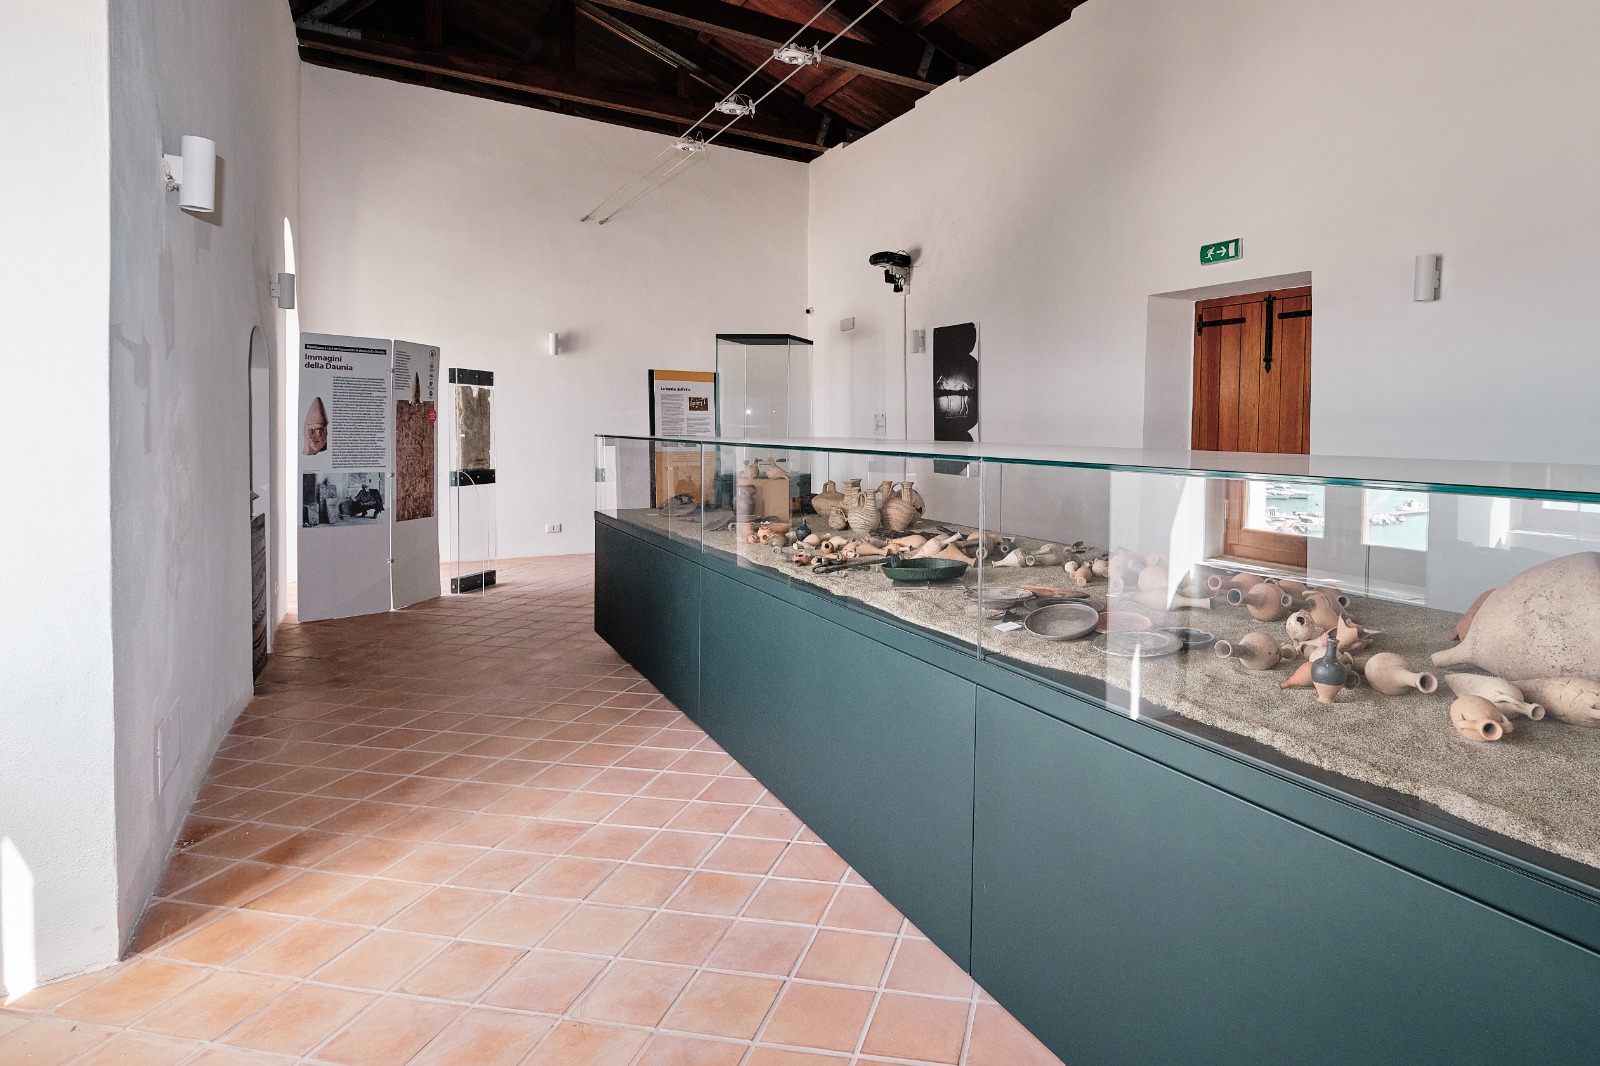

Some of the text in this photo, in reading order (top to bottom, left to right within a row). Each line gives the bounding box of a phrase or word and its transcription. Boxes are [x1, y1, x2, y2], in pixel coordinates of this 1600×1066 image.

[304, 353, 342, 363] Immagini
[304, 361, 353, 371] della Daunia
